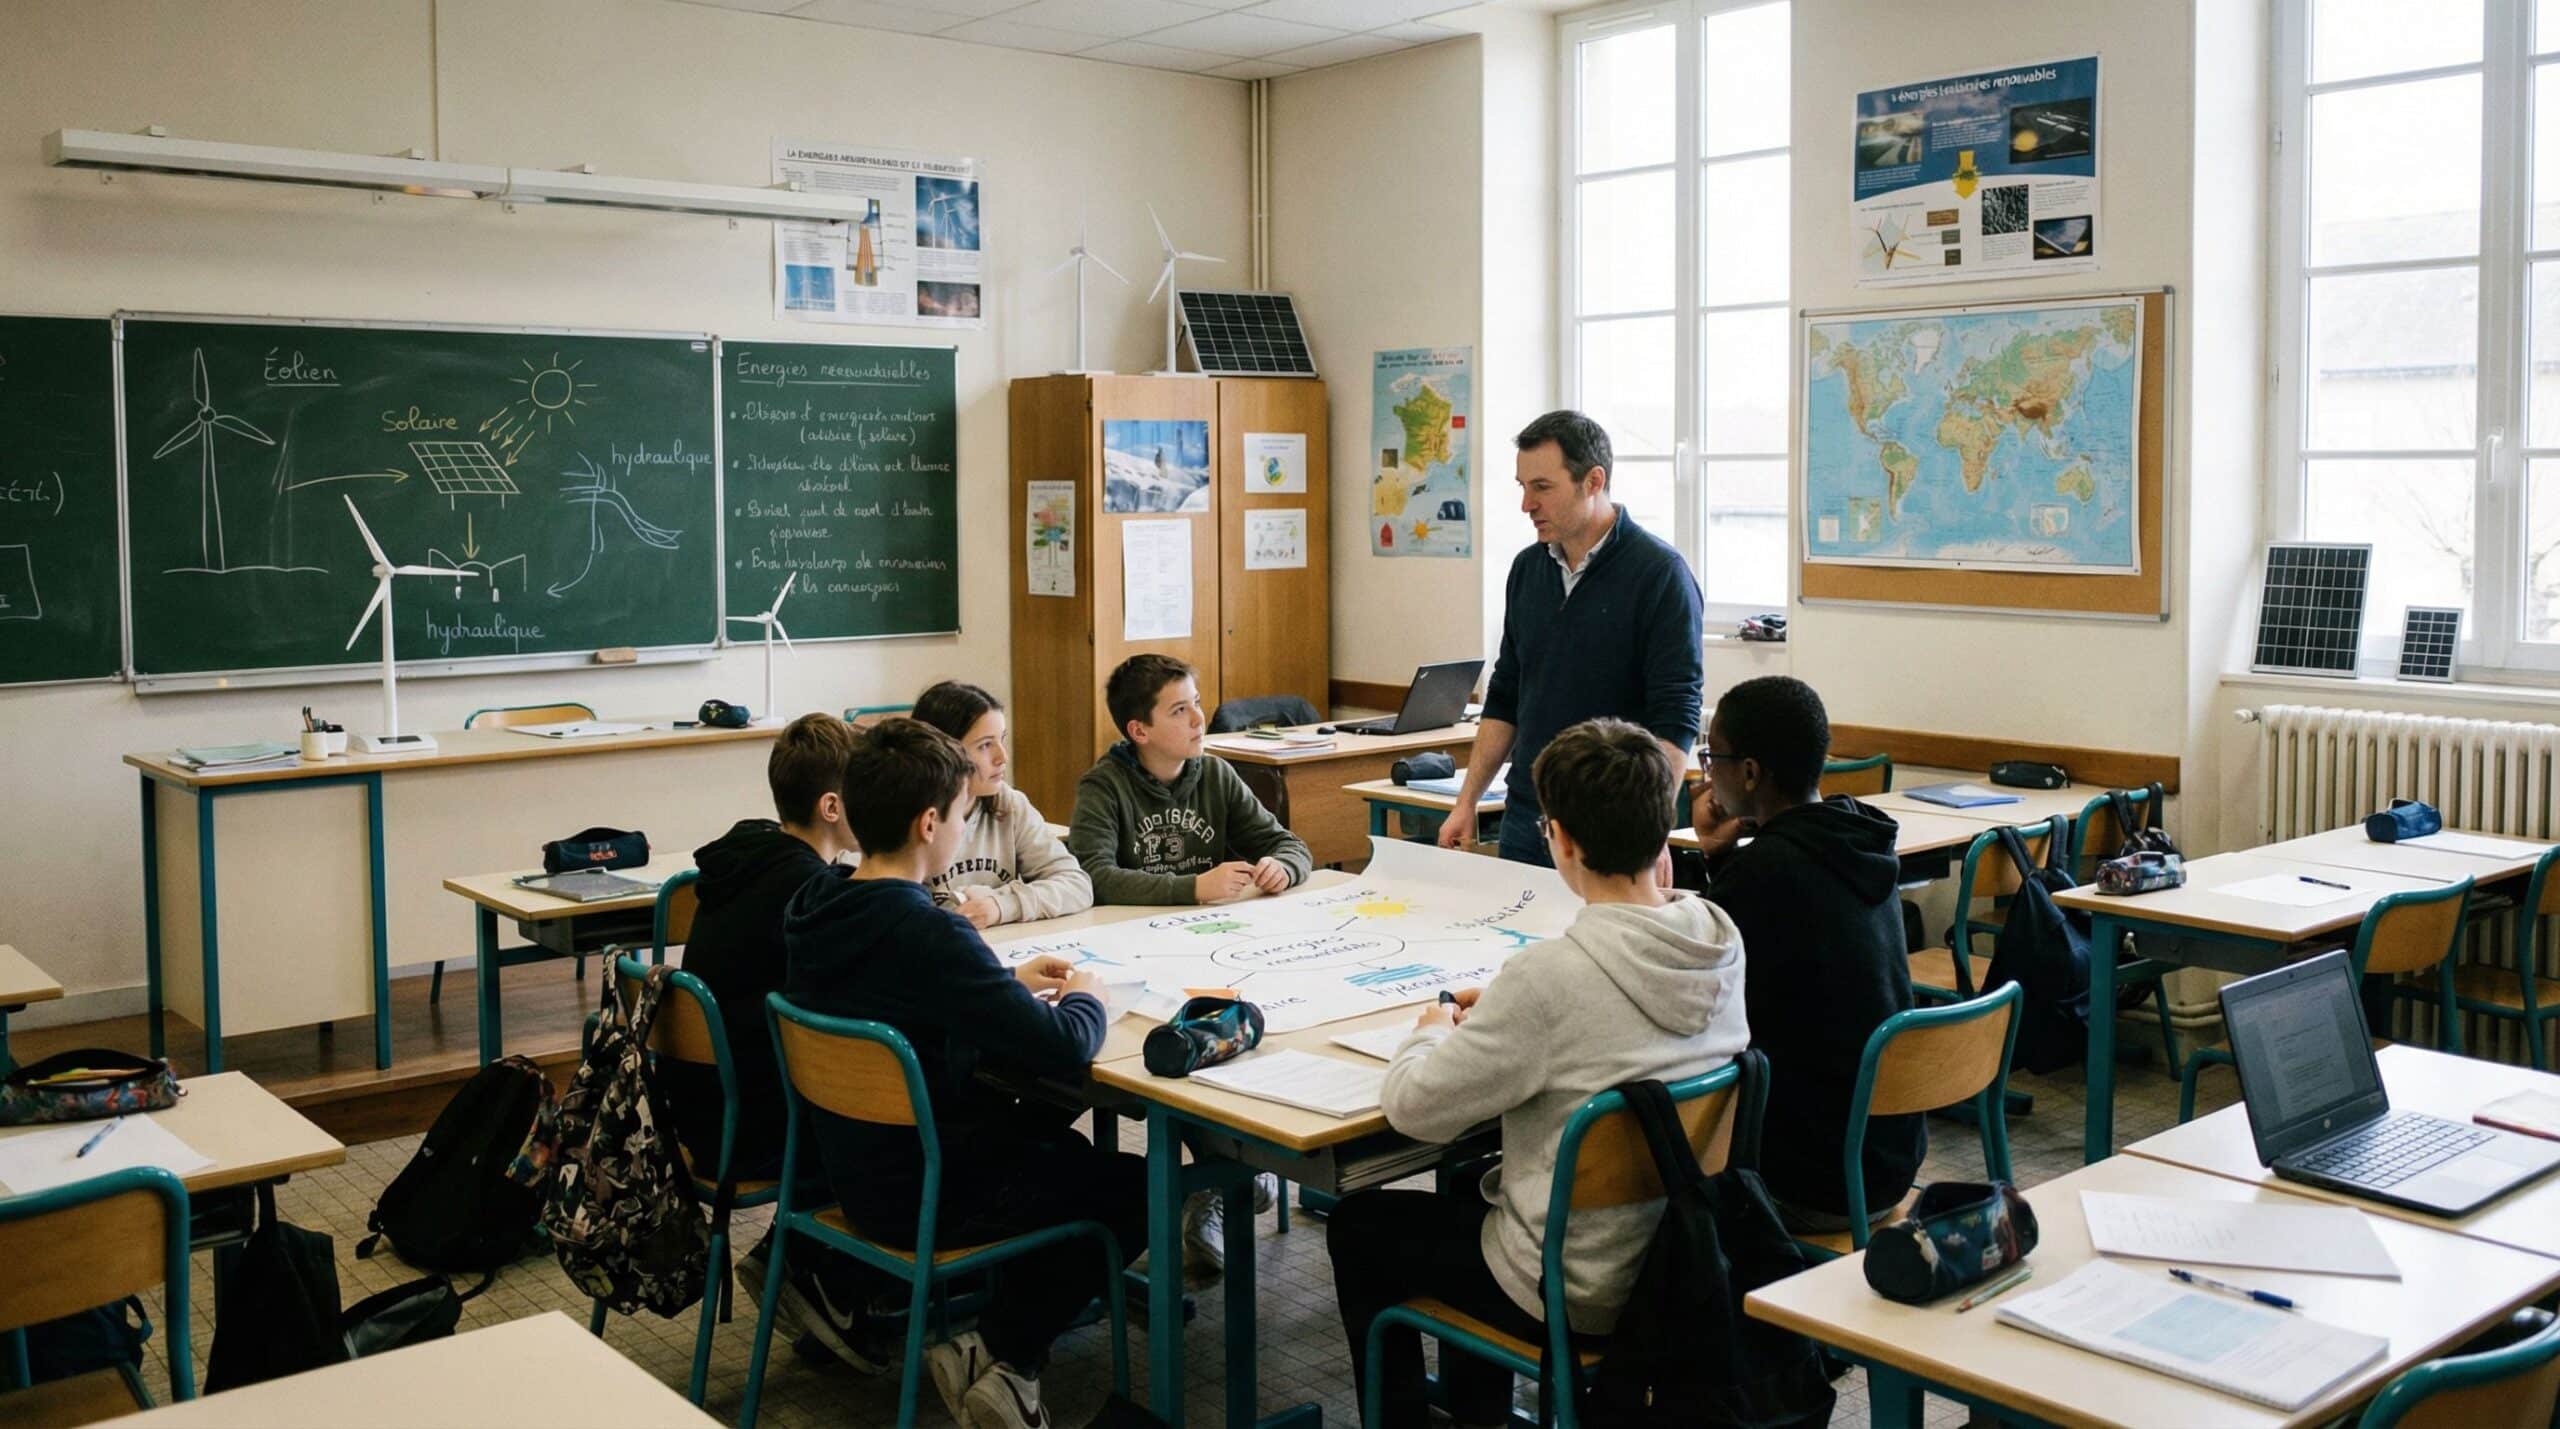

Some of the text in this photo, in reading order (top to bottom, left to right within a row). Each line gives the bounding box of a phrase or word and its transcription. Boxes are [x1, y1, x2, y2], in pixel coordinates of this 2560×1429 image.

[737, 352, 808, 388] Energies
[382, 406, 459, 432] Solaire
[425, 608, 545, 656] hydraulique
